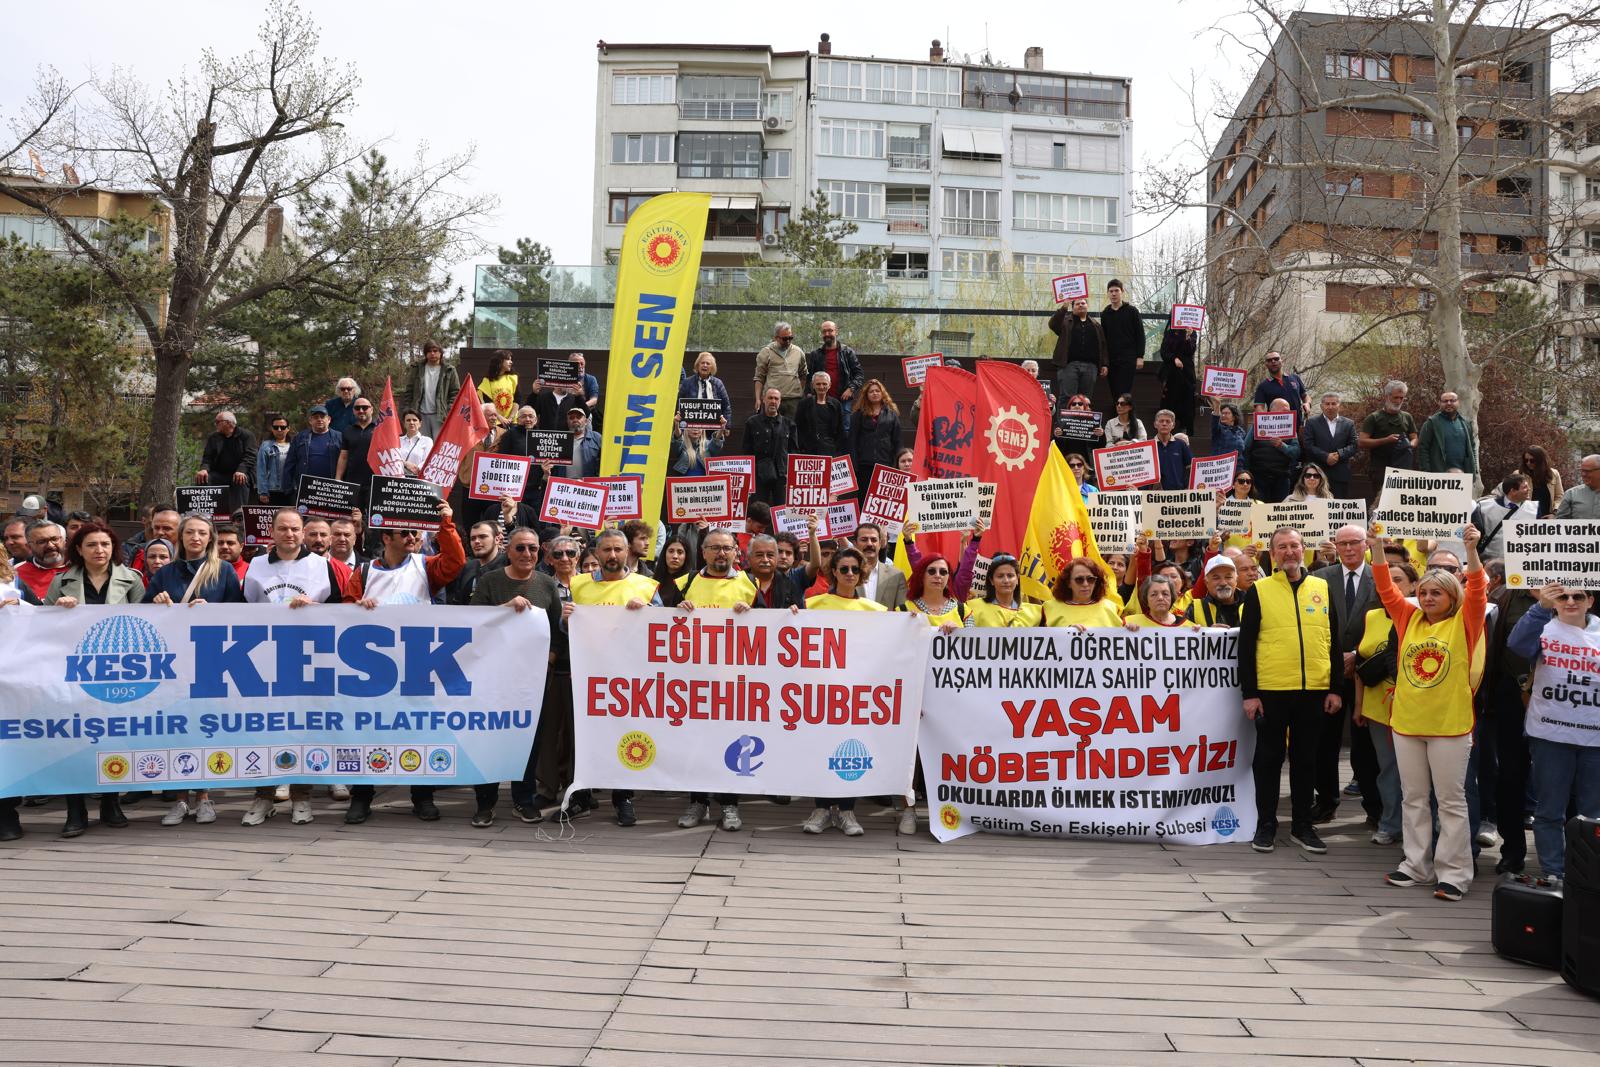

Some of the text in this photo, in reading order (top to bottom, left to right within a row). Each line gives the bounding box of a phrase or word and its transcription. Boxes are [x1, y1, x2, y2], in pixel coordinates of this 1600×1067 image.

[631, 293, 677, 379] SEN
[680, 402, 722, 410] YUSUF TEKİN
[684, 410, 717, 419] İSTİFA!
[490, 459, 521, 470] EĞİTİMDE
[797, 460, 823, 470] YUSUF
[481, 471, 510, 483] ŞİDDETE
[797, 471, 822, 485] TEKİN
[881, 471, 908, 487] YUSUF
[400, 482, 431, 490] ÇOCUKTAN
[557, 484, 571, 494] EŞİT,
[573, 487, 598, 498] PARASIZ
[699, 485, 725, 494] YAŞAMAK
[879, 484, 904, 500] TEKİN
[914, 480, 974, 492] Yaşatmak için
[789, 485, 828, 505] İSTİFA
[1146, 493, 1187, 504] Güvenli
[1400, 494, 1437, 506] Bakan
[865, 493, 905, 520] İSTİFA
[931, 501, 958, 510] Ölmek
[1160, 505, 1201, 515] Güvenli
[918, 509, 972, 521] İstemiyoruz!
[1112, 507, 1129, 517] Can
[1267, 514, 1287, 522] kalbi
[1346, 511, 1365, 520] Okul
[1417, 510, 1468, 524] bakıyor!
[872, 517, 889, 527] EHP
[1091, 520, 1128, 531] venliği
[1157, 517, 1205, 529] Gelecek!
[1402, 527, 1411, 536] Sen
[1515, 523, 1562, 538] Şiddet
[1507, 541, 1551, 556] başarı
[1526, 576, 1544, 587] Eğitim
[648, 616, 847, 669] EĞİTİM SEN
[932, 632, 1238, 662] OKULUMUZA, ÖĞRENCİLERİMİZ
[190, 624, 472, 698] KESK
[64, 653, 177, 682] KESK
[932, 663, 1240, 693] YAŞAM HAKKIMIZA SAHİP ÇIKIYORU
[1567, 671, 1592, 686] İLE
[104, 686, 137, 698] 1995
[587, 672, 902, 731] ESKİŞEHİR ŞUBESİ
[0, 710, 532, 743] ESKİŞEHİR ŞUBELER PLATFORMU
[1001, 694, 1180, 750] YAŞAM
[338, 761, 359, 770] BTS
[828, 756, 873, 770] KESK
[941, 735, 1237, 784] NÖBETİNDEYİZ!
[937, 784, 1048, 809] OKULLARDA
[1051, 786, 1115, 809] ÖLMEK
[970, 815, 1206, 839] Eğitim Sen Eskişehir Şubesi
[1211, 819, 1240, 829] KESK
